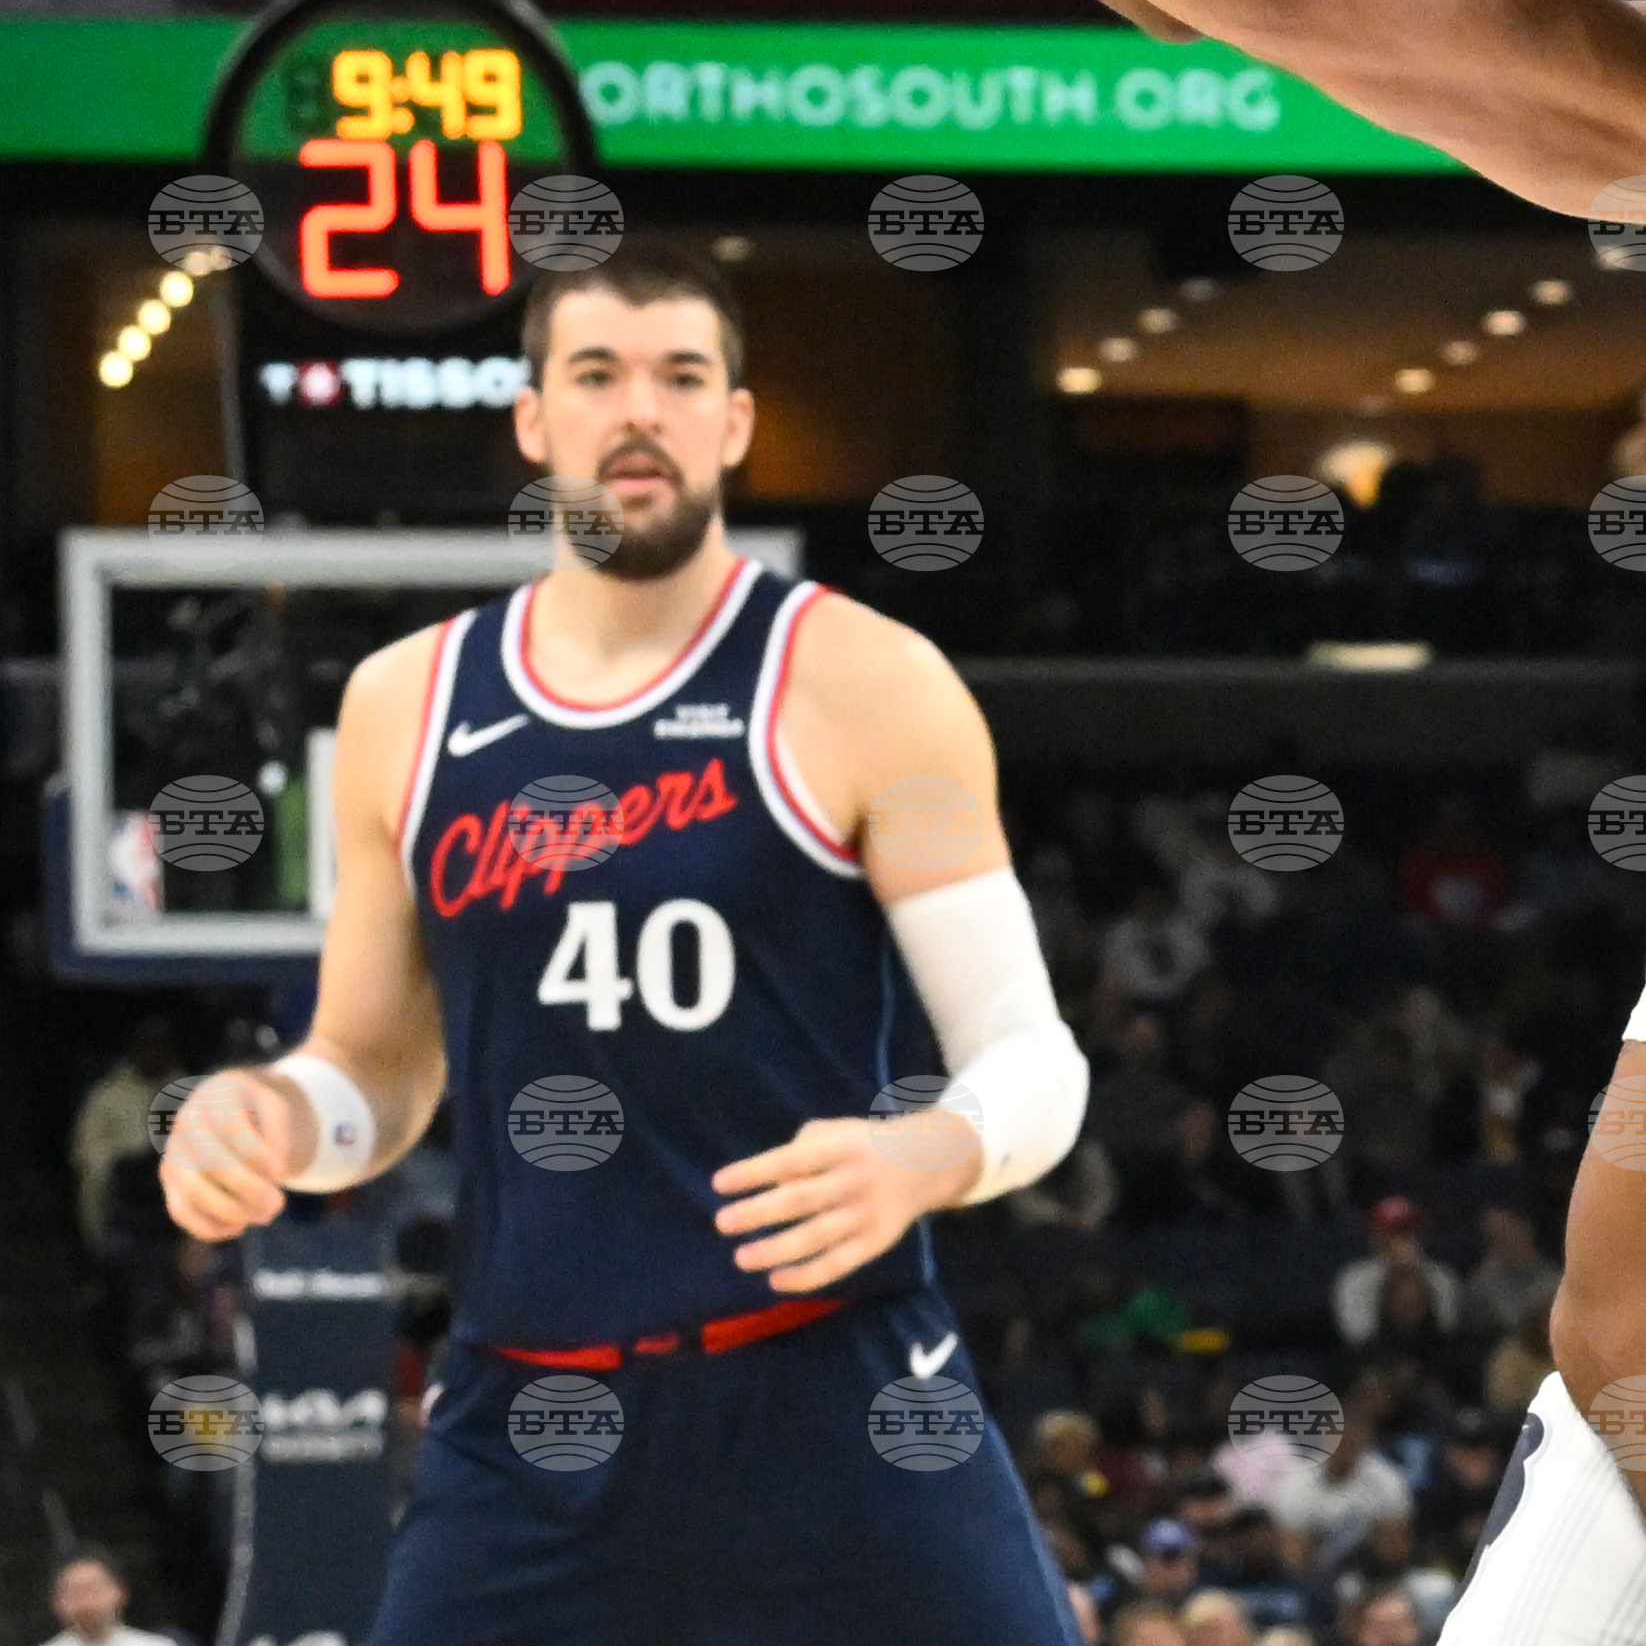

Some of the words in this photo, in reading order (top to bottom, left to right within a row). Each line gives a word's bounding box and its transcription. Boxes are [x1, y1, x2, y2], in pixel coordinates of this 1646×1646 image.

[331, 49, 522, 140] 9:49
[299, 138, 511, 298] 24
[430, 759, 738, 918] Clippers
[537, 898, 737, 1033] 40
